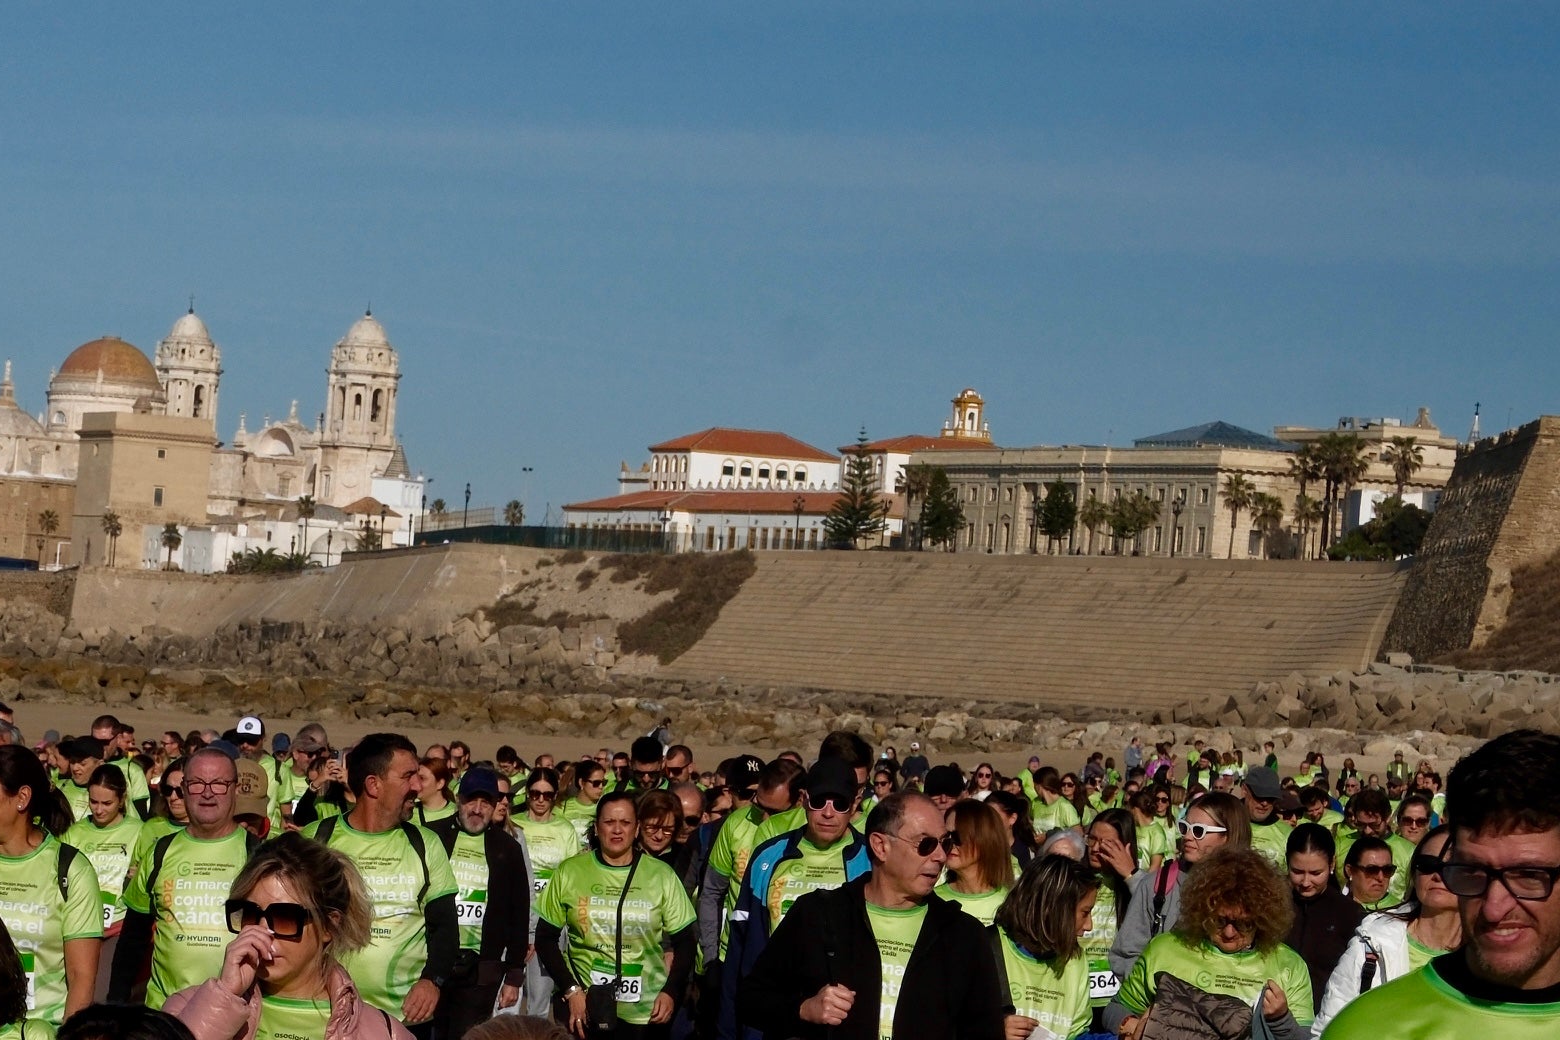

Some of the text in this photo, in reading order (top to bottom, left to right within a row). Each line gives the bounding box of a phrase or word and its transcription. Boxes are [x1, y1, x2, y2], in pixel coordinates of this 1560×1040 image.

[747, 760, 760, 771] NY
[176, 879, 191, 889] En
[786, 879, 803, 888] En
[174, 892, 225, 906] contra
[400, 890, 414, 901] el
[590, 897, 605, 906] En
[456, 904, 482, 918] 976
[638, 911, 650, 923] el
[26, 919, 43, 935] el
[1090, 974, 1117, 989] 564
